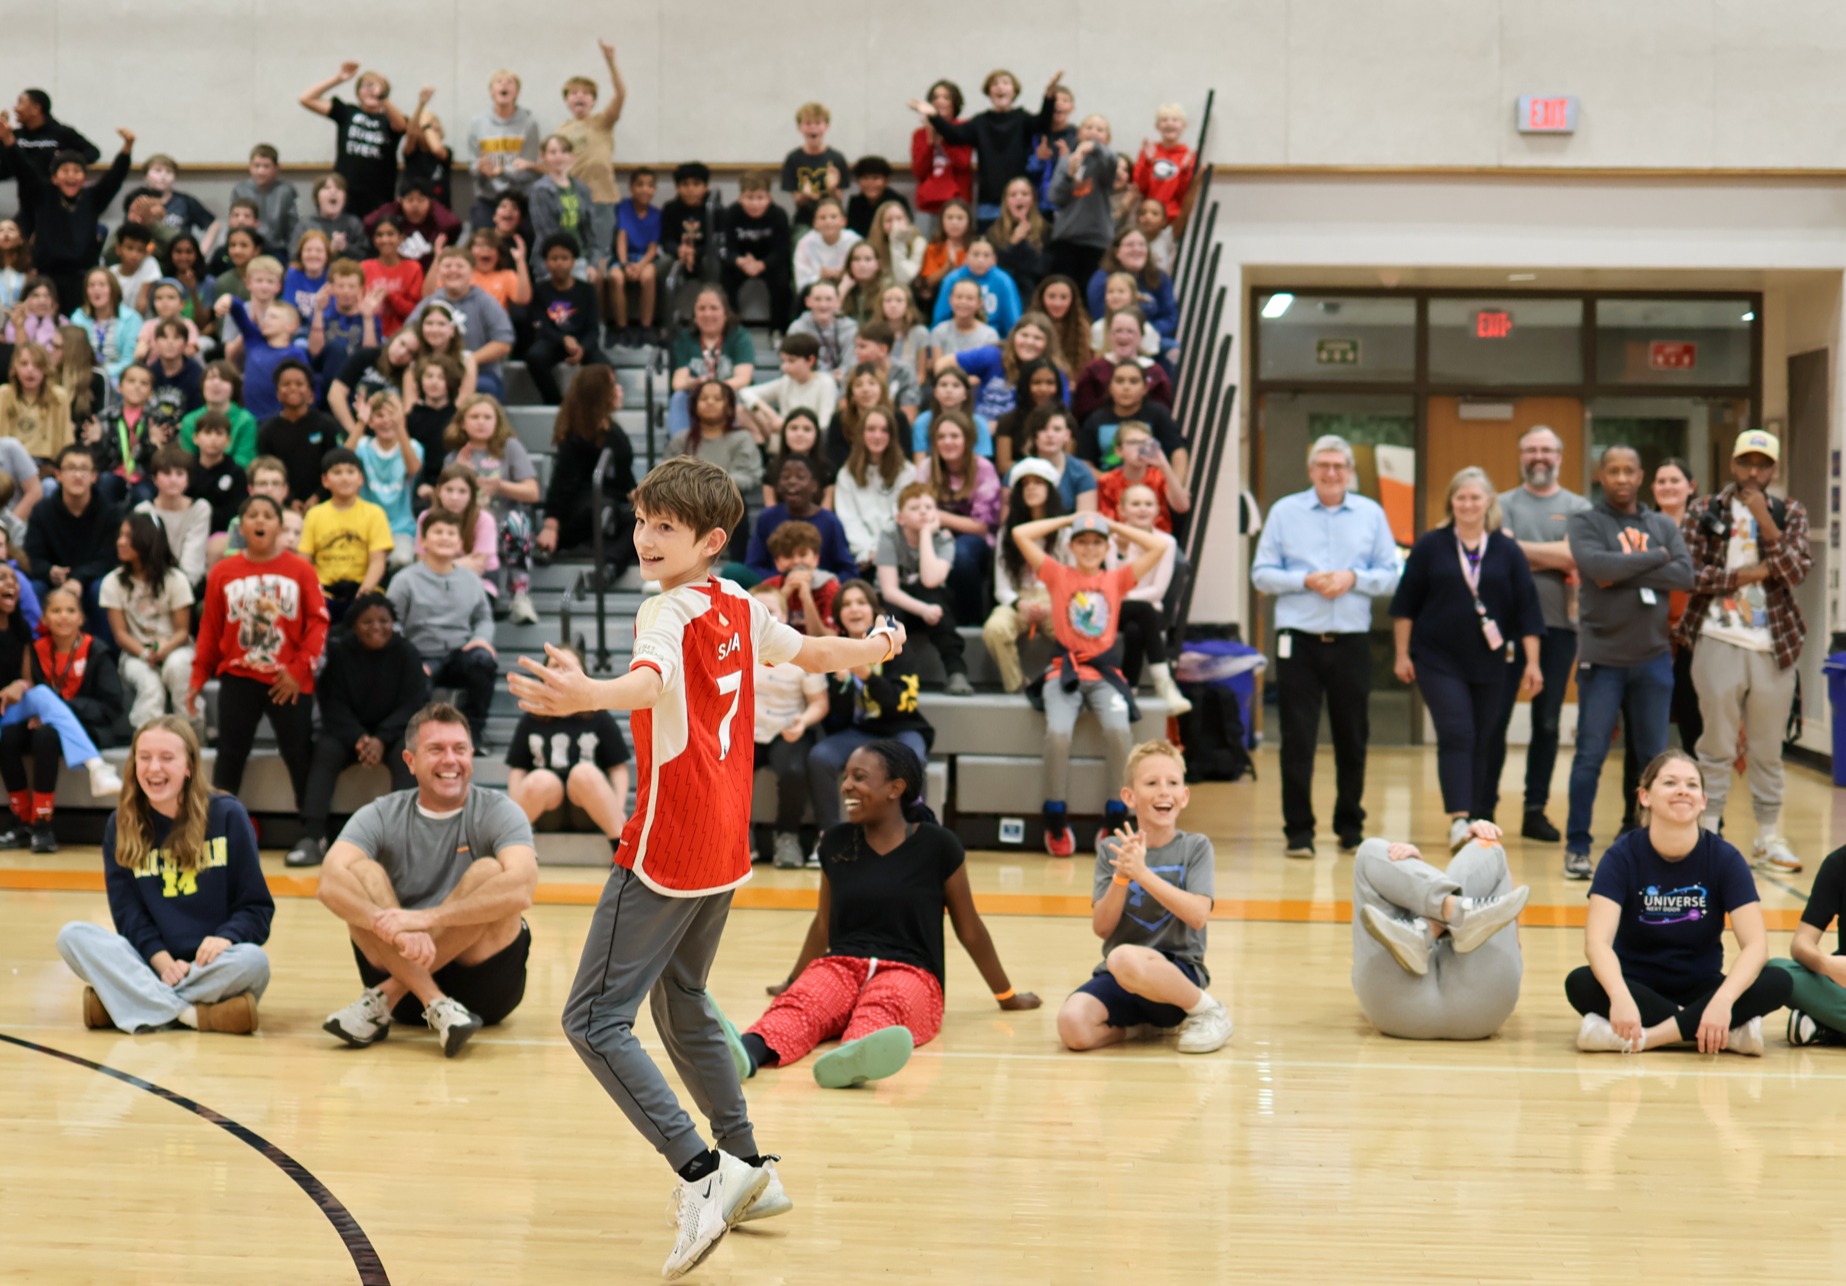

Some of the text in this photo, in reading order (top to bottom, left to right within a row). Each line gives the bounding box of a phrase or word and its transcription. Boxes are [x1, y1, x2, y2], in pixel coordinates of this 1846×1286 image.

[1530, 98, 1568, 129] EXIT
[1478, 311, 1508, 337] EXIT
[716, 670, 742, 760] 7
[1644, 895, 1707, 908] UNIVERSE
